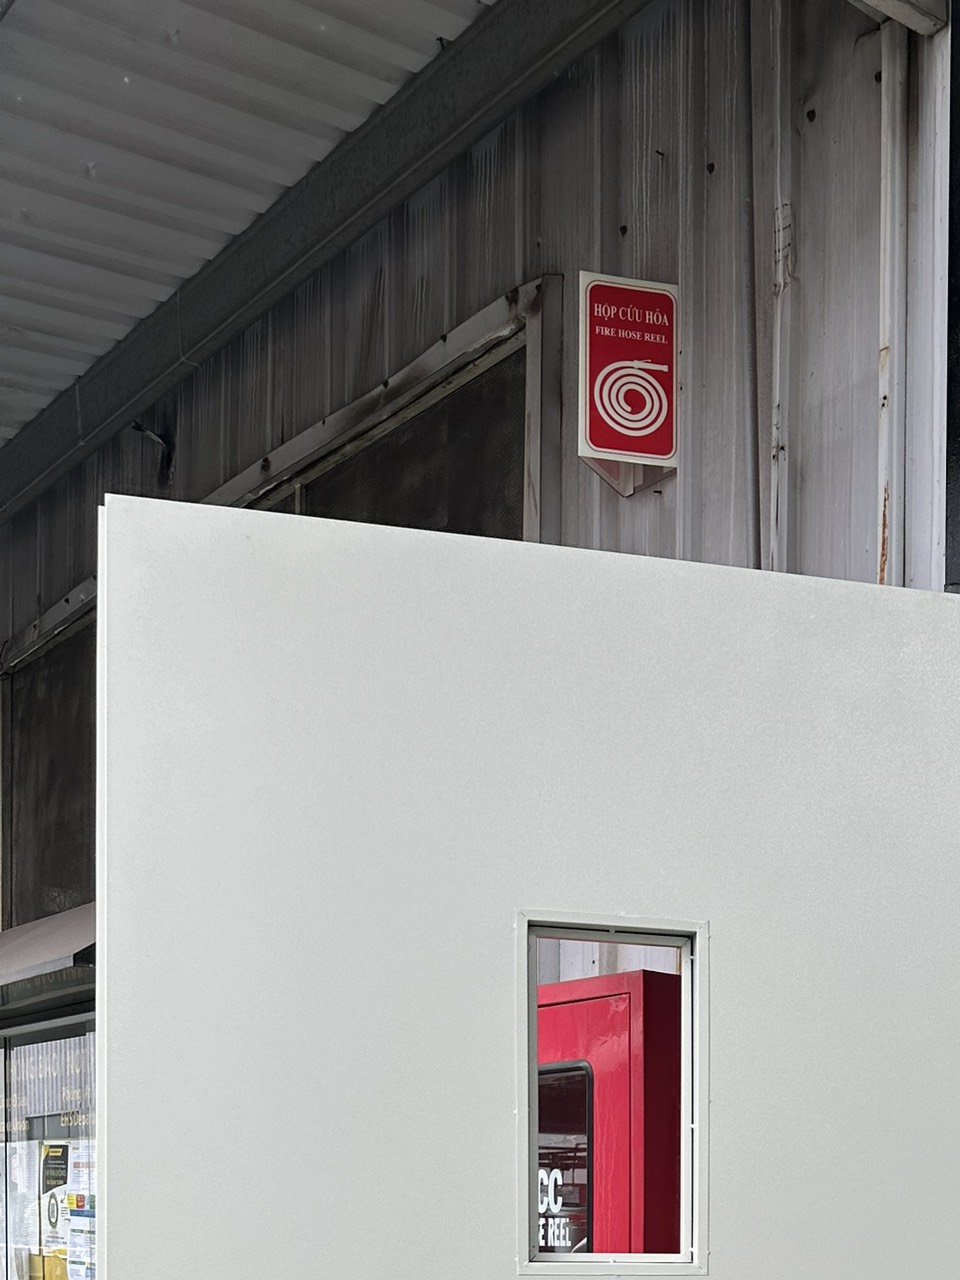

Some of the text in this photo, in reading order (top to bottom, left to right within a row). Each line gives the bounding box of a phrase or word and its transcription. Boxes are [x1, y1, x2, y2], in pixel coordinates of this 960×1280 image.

[594, 303, 617, 321] HỘP
[618, 305, 644, 323] CỨU
[595, 325, 668, 344] FIRE HOSE REEL
[547, 1217, 572, 1247] REEL
